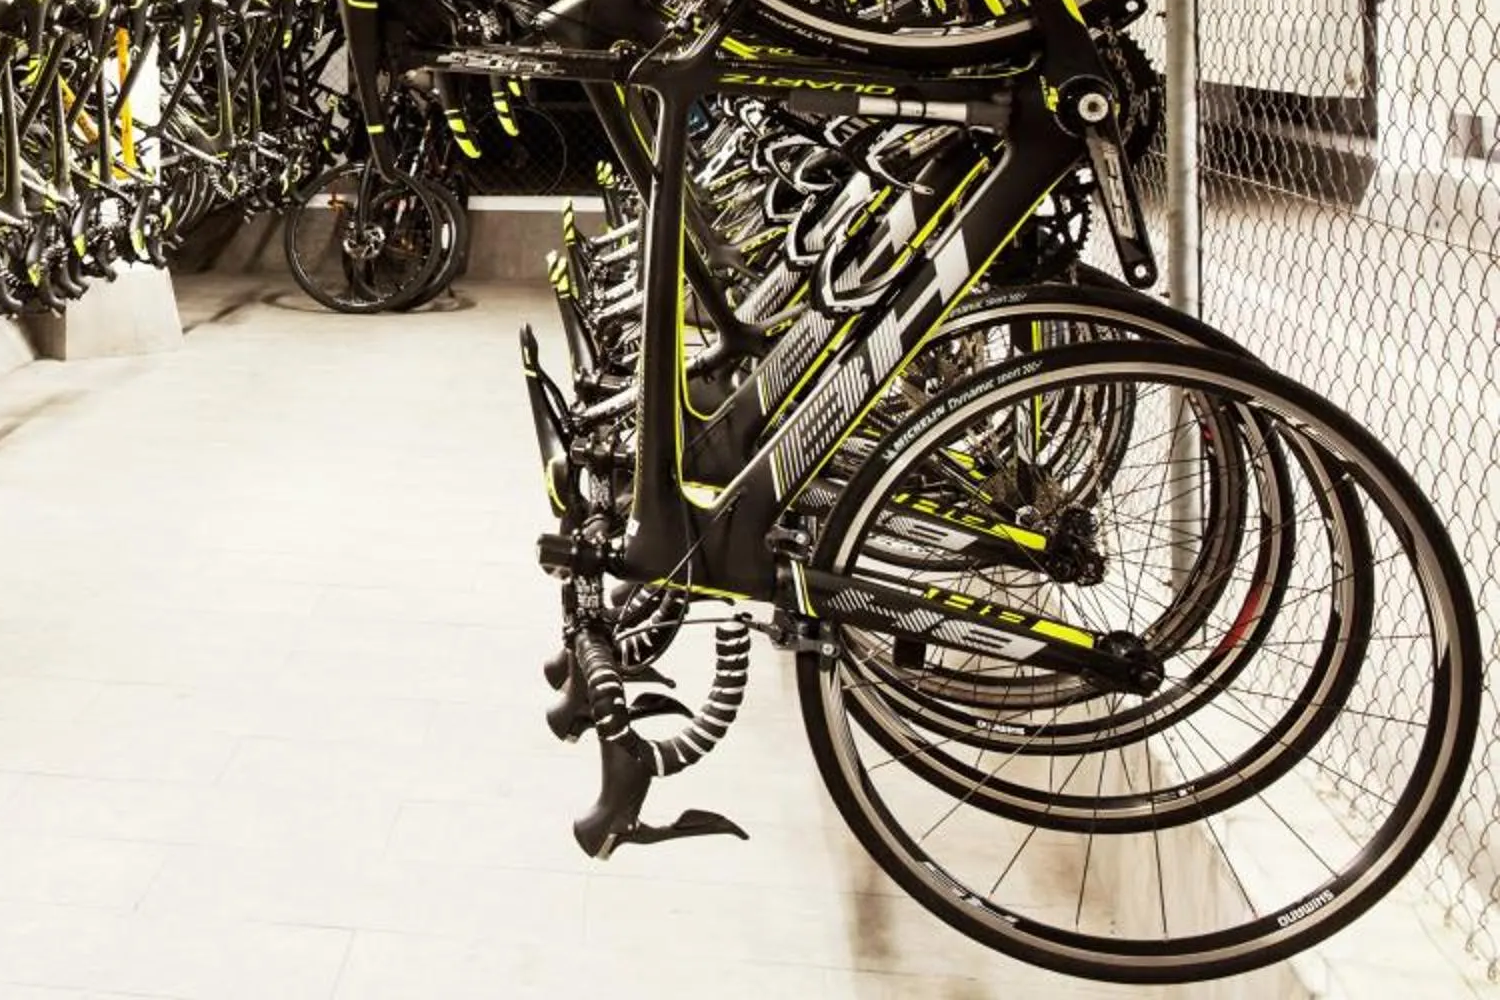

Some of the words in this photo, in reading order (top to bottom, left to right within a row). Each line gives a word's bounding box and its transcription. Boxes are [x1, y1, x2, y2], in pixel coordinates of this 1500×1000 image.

[720, 73, 897, 96] QUARTZ
[769, 228, 970, 502] BH
[893, 404, 946, 452] MICHELIN
[947, 378, 996, 410] Dynamic
[1277, 889, 1335, 927] SHIMANO
